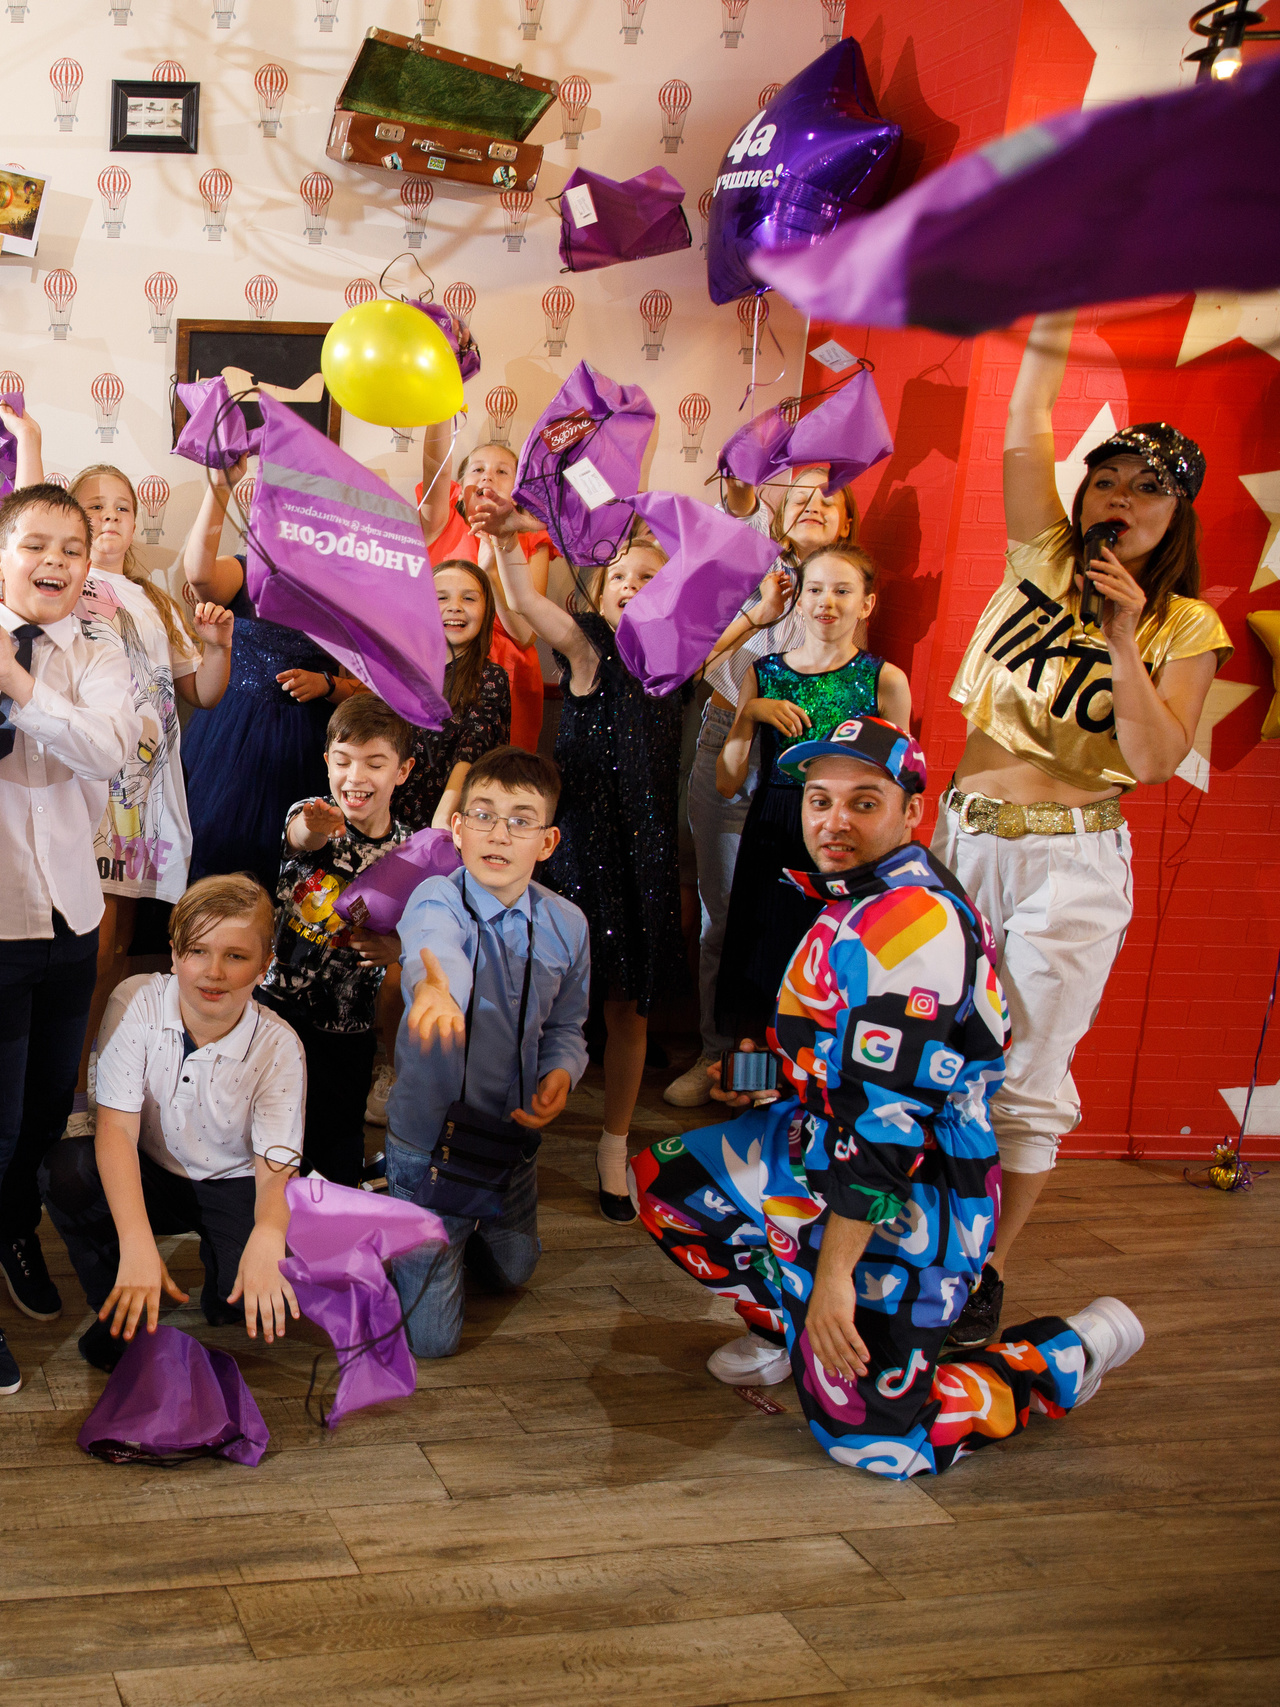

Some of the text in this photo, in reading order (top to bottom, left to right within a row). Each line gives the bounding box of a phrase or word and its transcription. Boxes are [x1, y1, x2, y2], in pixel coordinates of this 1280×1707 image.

[712, 162, 784, 198] учшие!
[983, 578, 1153, 742] TikTo
[859, 1029, 895, 1064] G
